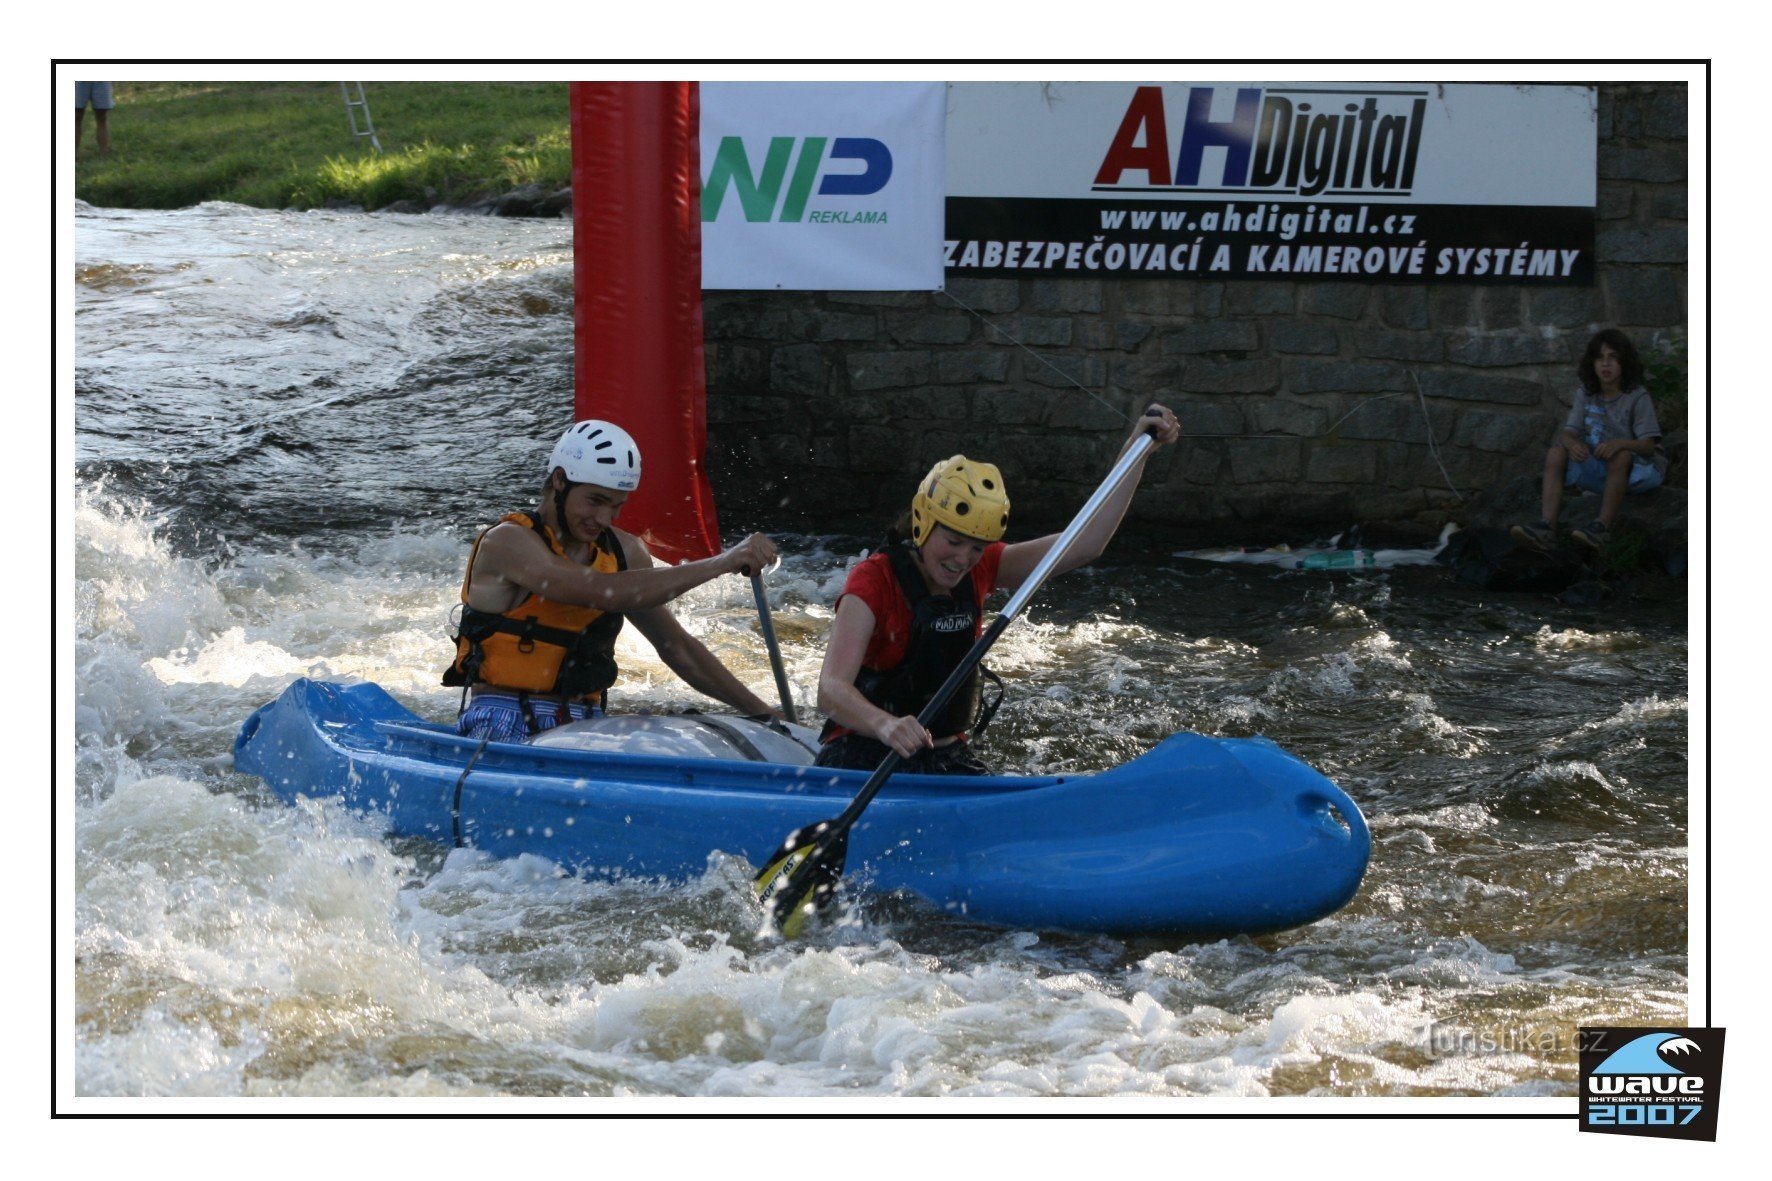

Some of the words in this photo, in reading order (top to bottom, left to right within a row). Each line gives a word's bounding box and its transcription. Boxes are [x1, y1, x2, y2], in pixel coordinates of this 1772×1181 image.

[808, 210, 888, 224] REKLAMA
[1100, 205, 1417, 240] www.ahdigital.cz
[944, 236, 1203, 271] ZABEZPEČOVACÍ
[1210, 244, 1231, 272] A
[1247, 240, 1429, 275] KAMEROVÉ
[1435, 242, 1580, 277] SYSTÉMY
